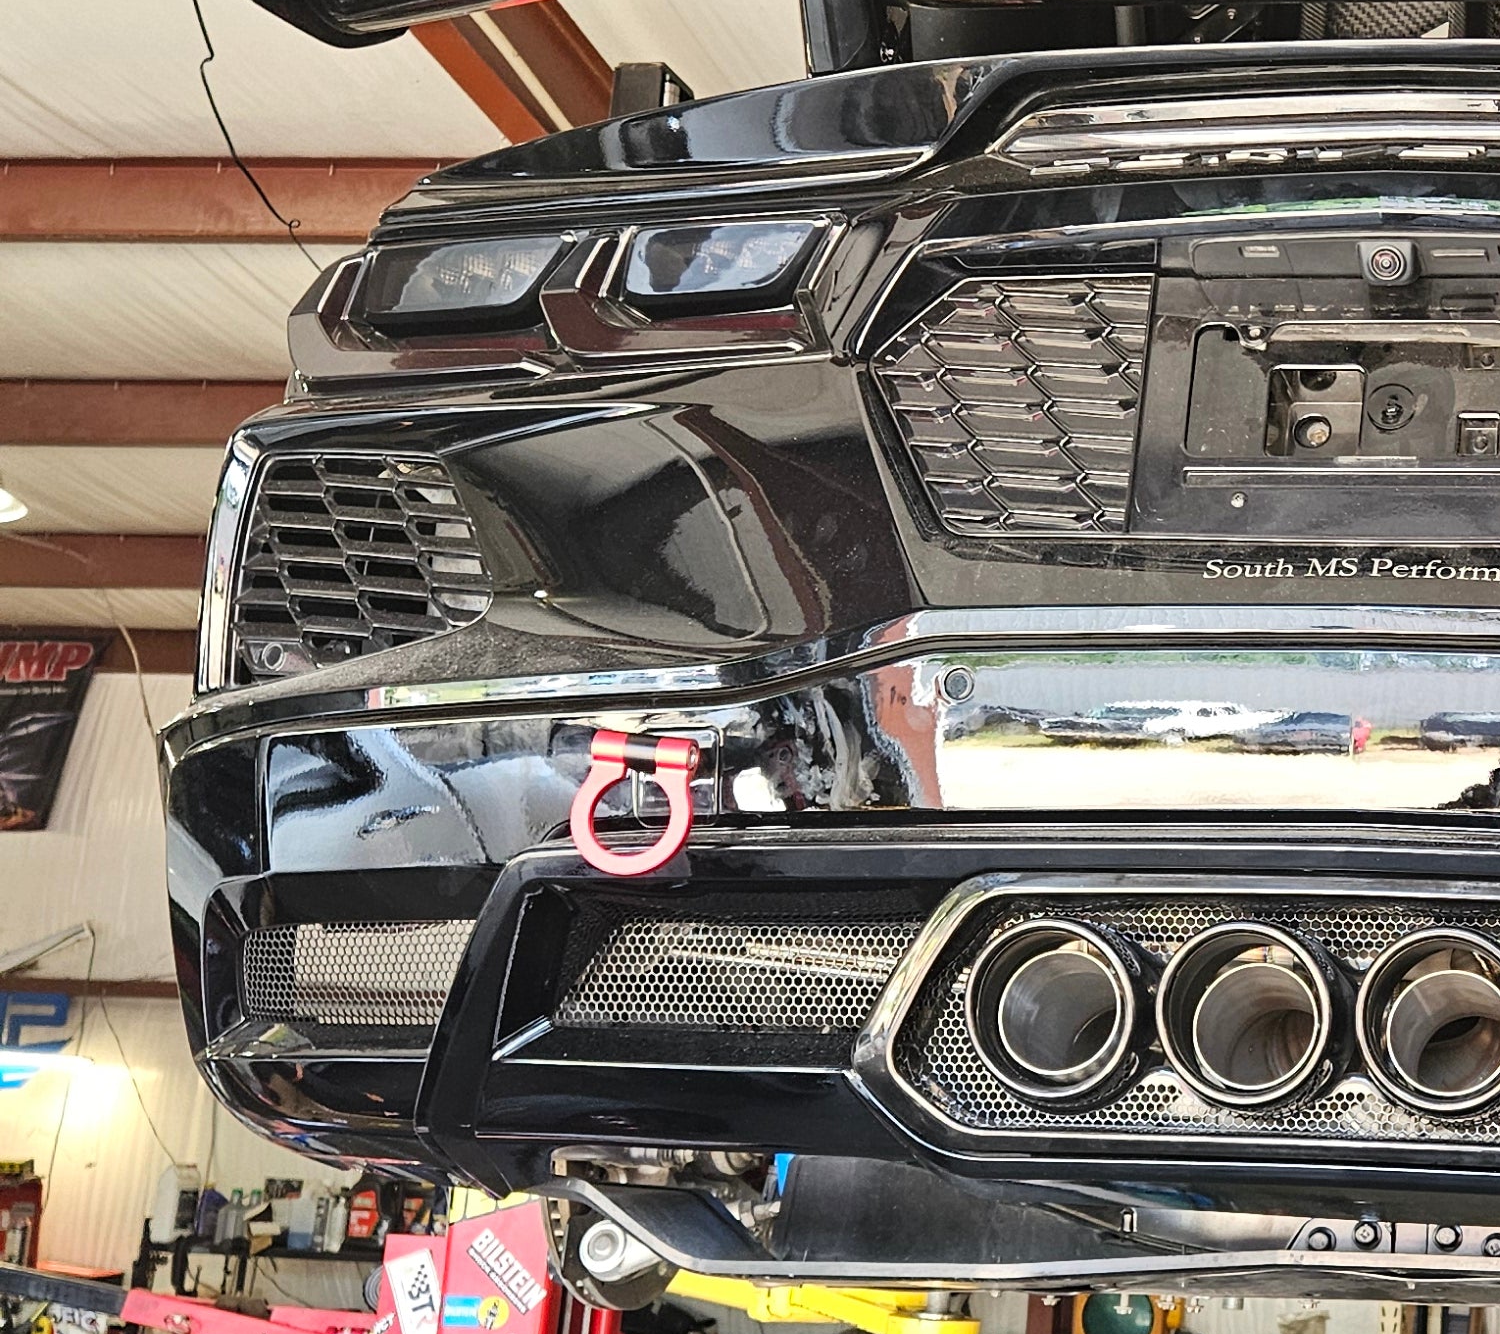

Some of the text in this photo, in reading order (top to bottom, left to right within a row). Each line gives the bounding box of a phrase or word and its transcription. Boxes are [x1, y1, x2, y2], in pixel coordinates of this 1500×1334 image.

[1202, 558, 1295, 580] South
[1303, 557, 1360, 578] MS
[471, 1227, 548, 1311] BILSTEIN
